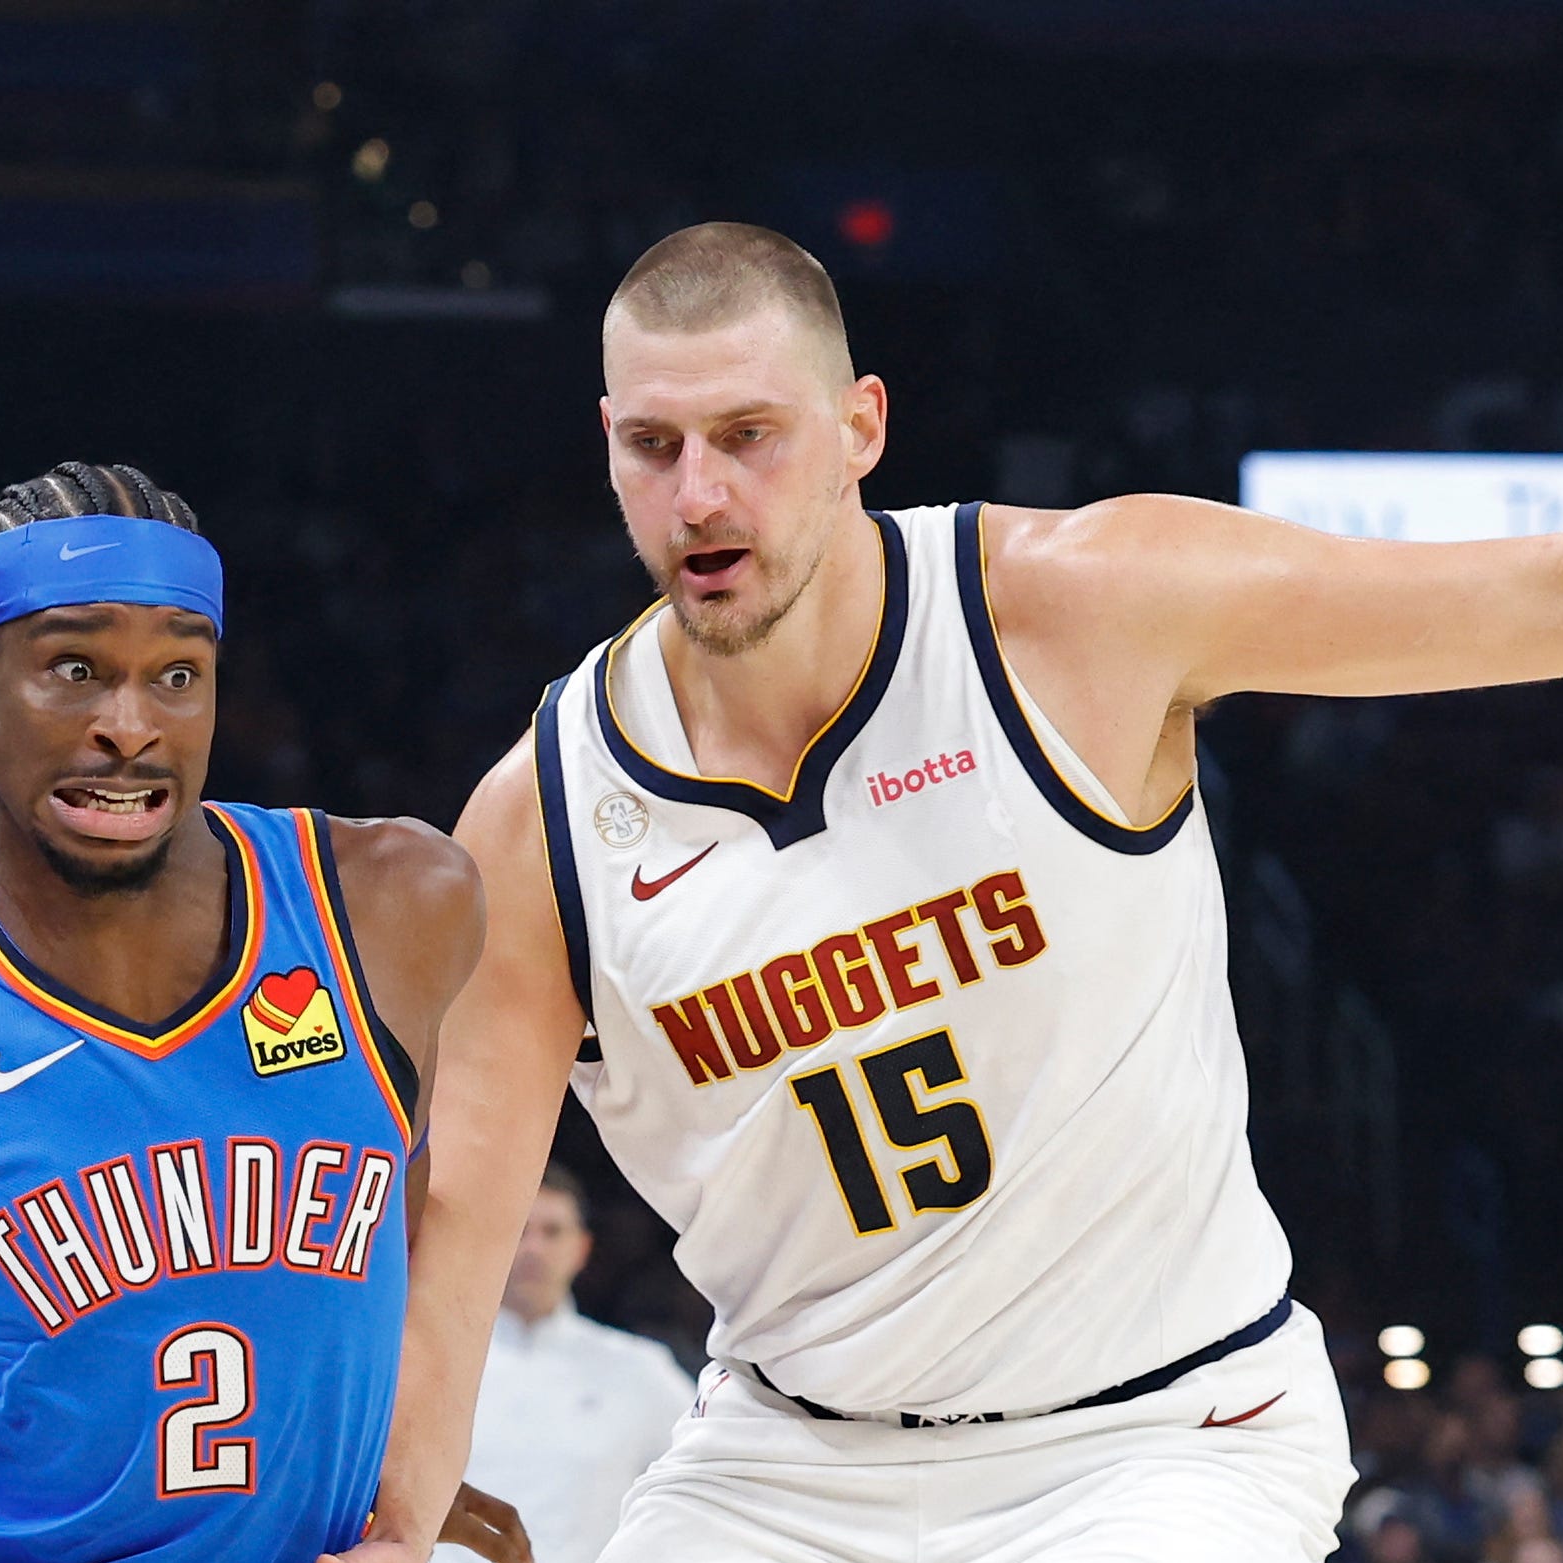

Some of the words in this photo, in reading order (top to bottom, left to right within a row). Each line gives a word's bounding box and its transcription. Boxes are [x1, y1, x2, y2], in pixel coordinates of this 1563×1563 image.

[867, 748, 976, 807] ibotta
[648, 868, 1050, 1089] NUGGETS
[786, 1025, 995, 1237] 15
[154, 1320, 257, 1500] 2
